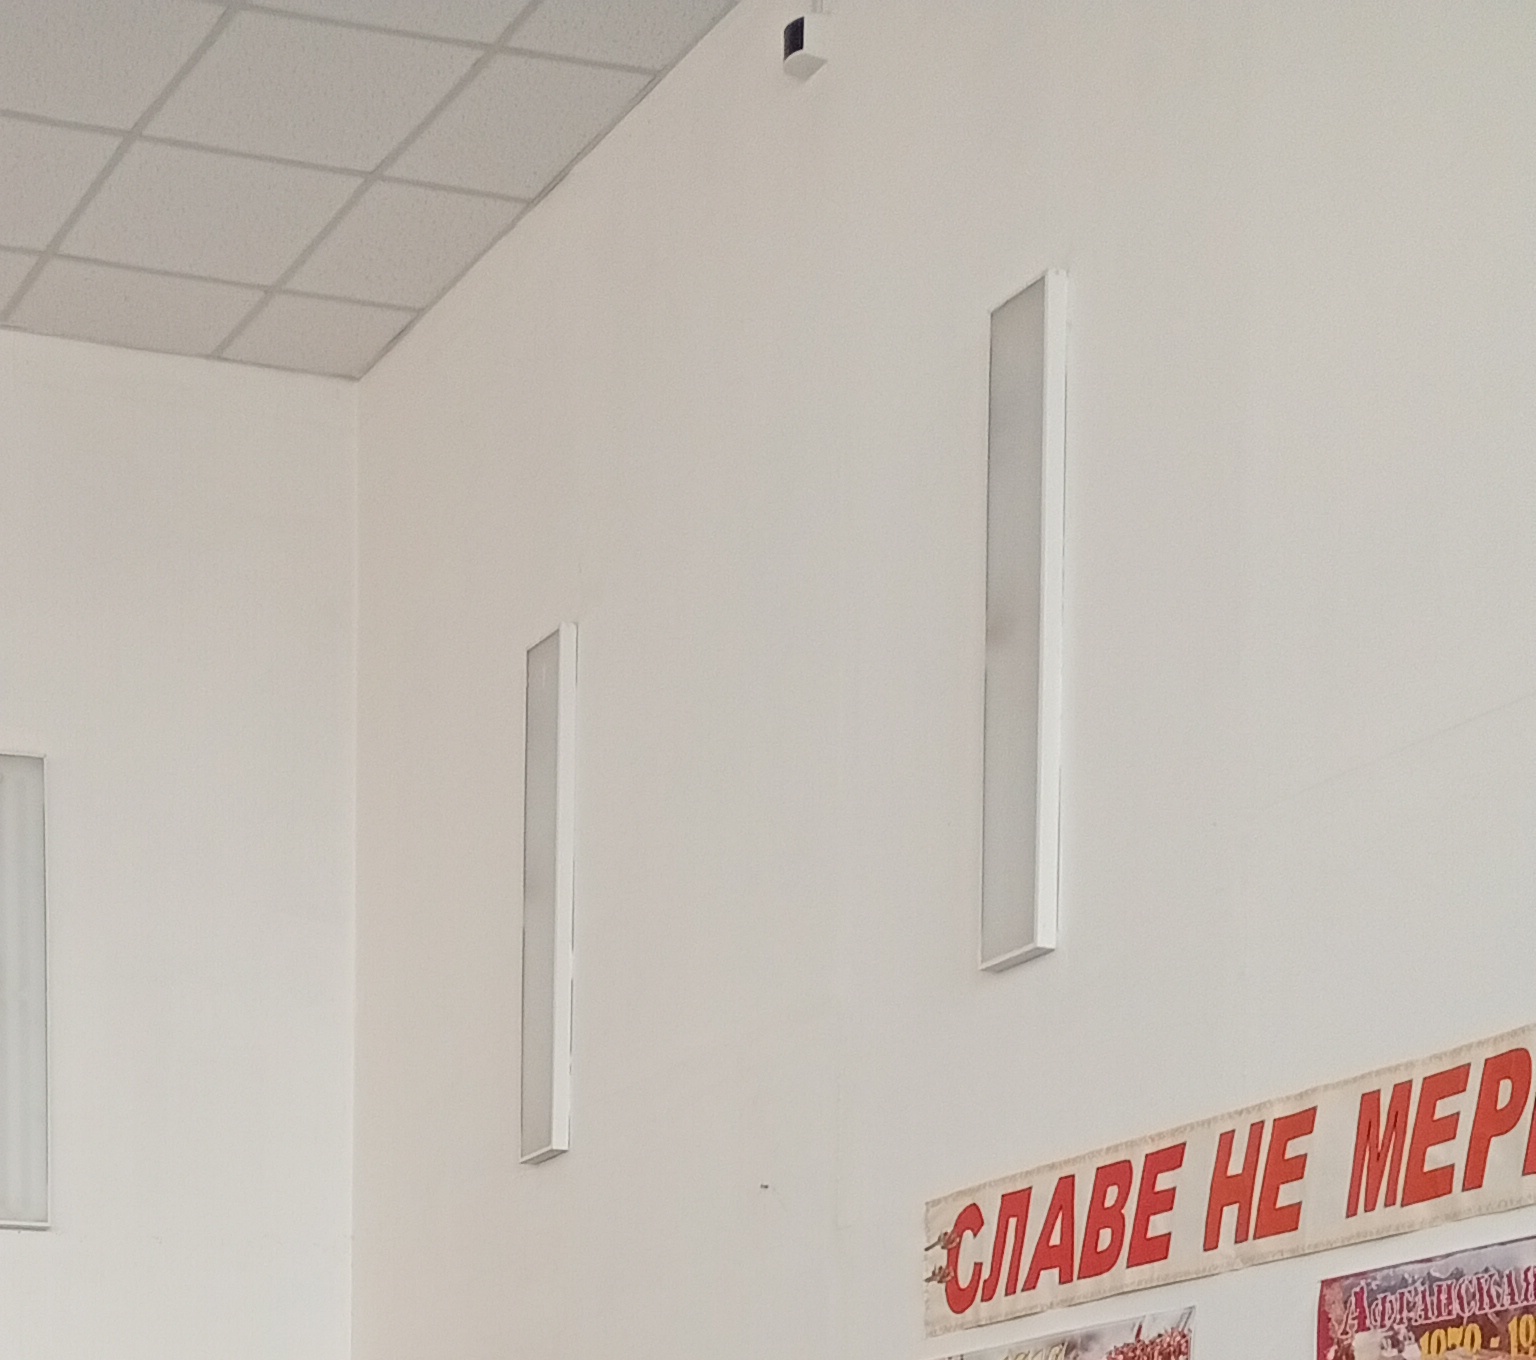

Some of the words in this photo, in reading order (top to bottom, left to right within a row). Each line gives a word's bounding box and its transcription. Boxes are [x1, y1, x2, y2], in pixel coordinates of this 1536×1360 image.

[944, 1142, 1187, 1315] СЛАВЕ
[1203, 1105, 1318, 1253] НЕ
[1346, 1046, 1536, 1219] МЕР
